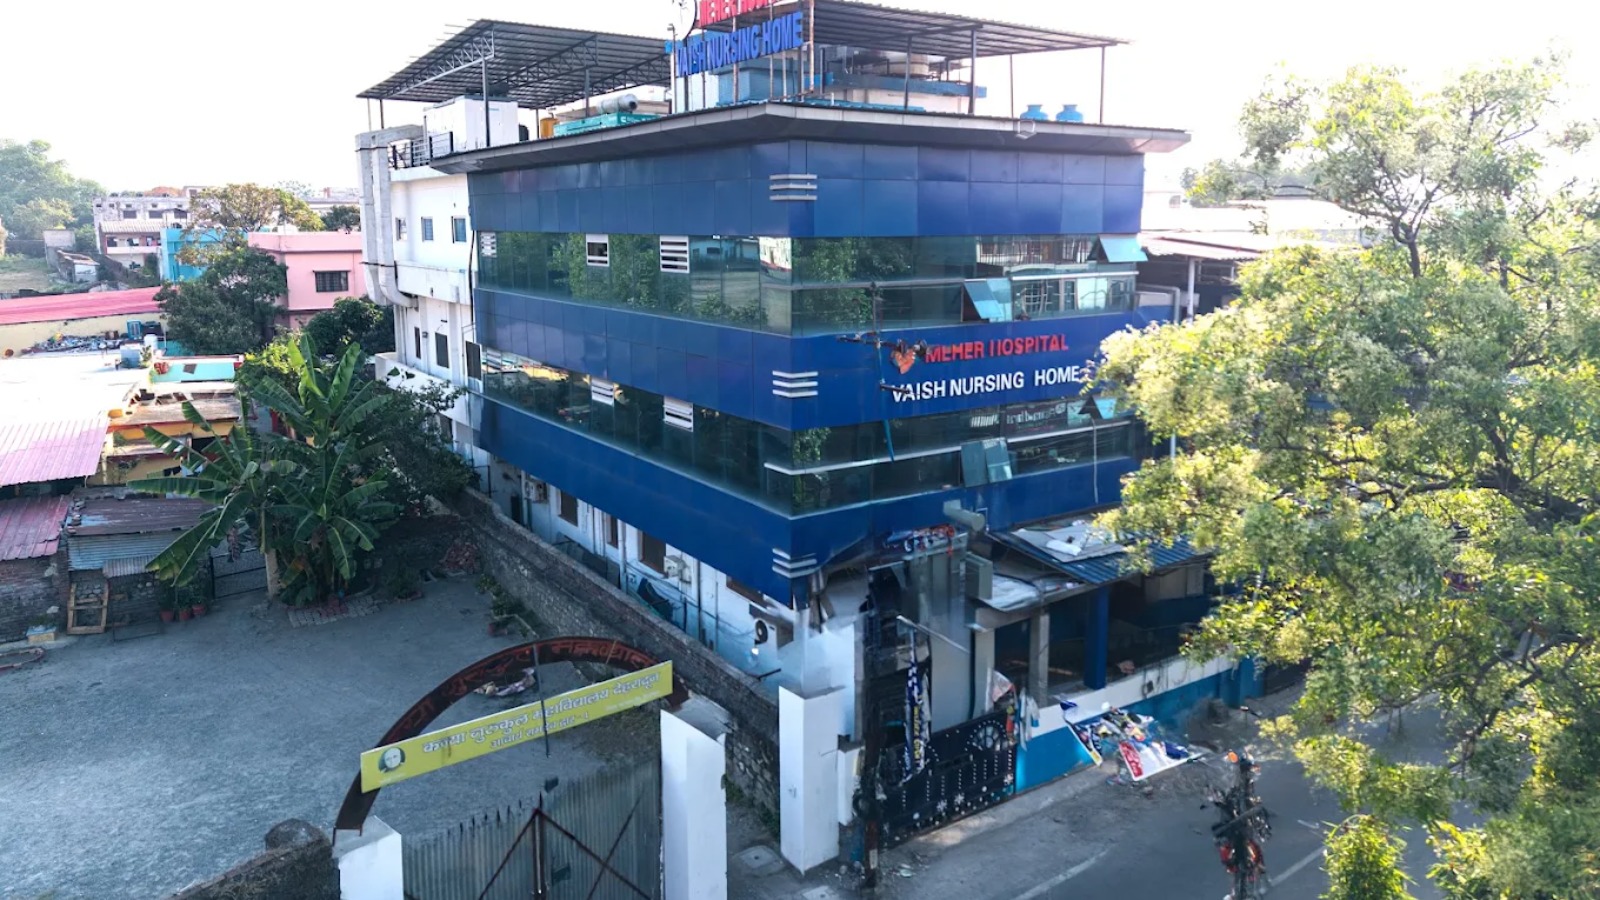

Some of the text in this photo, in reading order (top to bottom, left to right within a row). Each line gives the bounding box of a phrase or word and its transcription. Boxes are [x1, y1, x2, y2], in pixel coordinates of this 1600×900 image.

[677, 12, 803, 77] VAISH NURSING HOME
[925, 333, 1069, 363] MEHER HOSPITAL
[892, 365, 1080, 403] VAISH NURSING HOME
[470, 713, 528, 743] गुरुकुल
